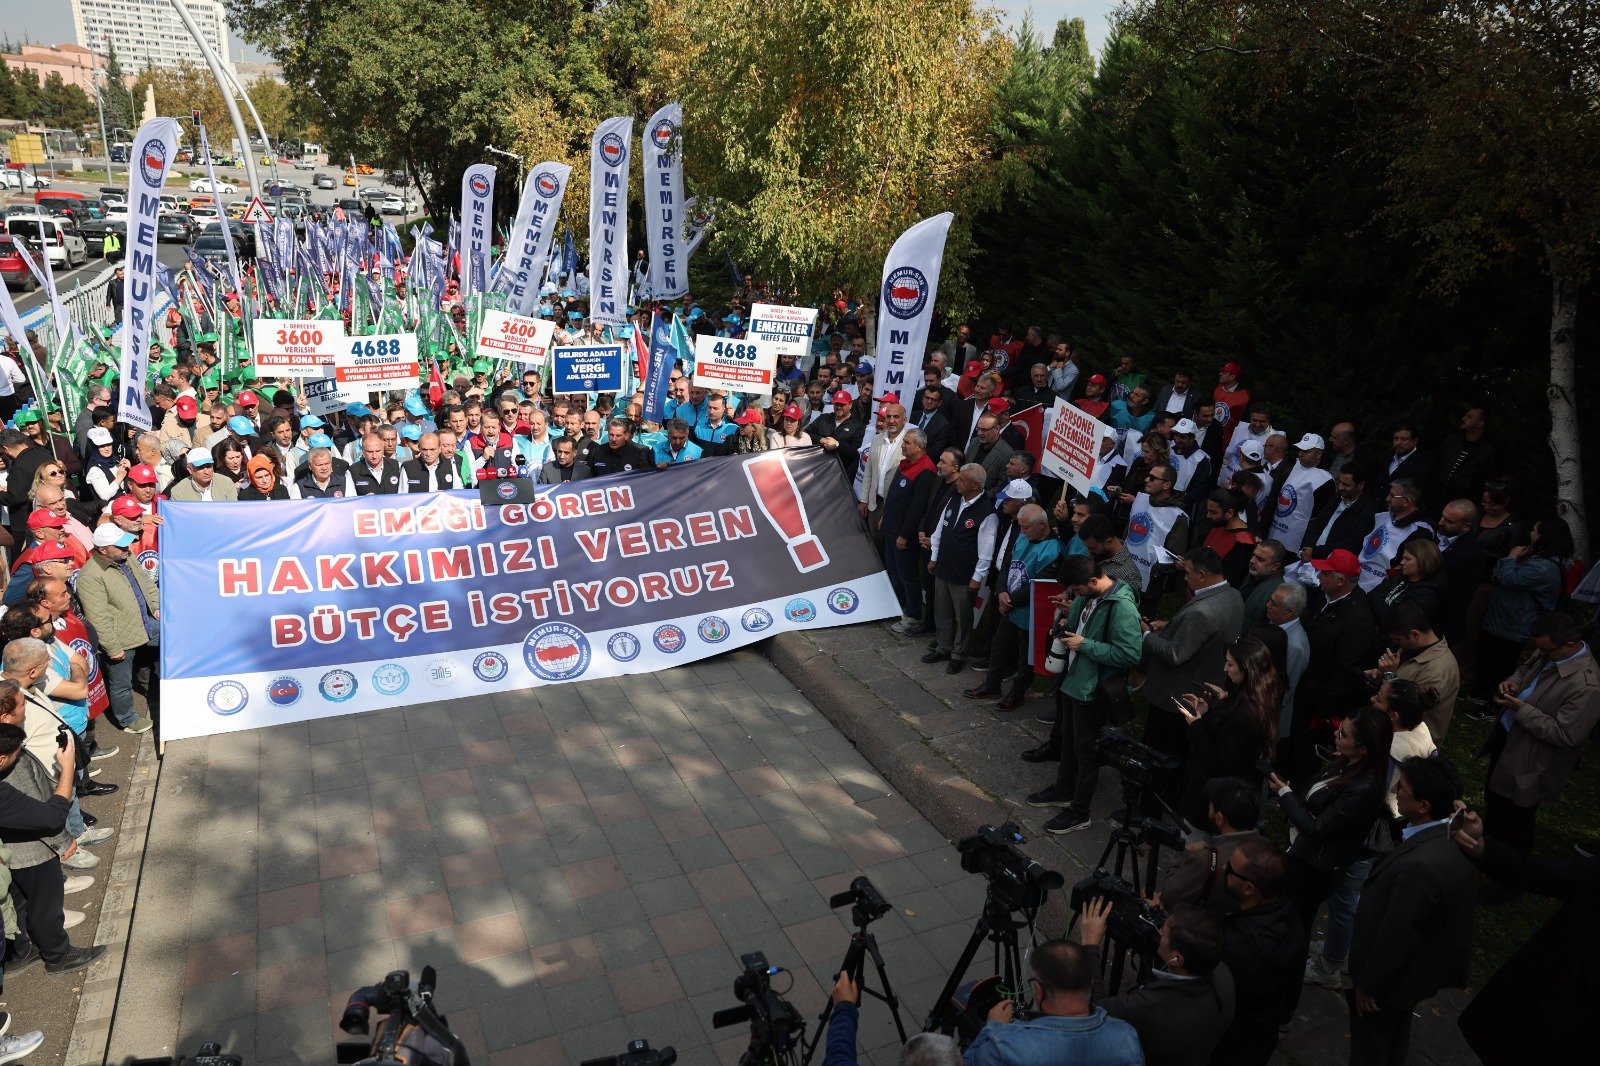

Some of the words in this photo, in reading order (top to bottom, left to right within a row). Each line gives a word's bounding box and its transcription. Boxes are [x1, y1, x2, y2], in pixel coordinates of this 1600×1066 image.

[472, 200, 485, 252] MEMU
[600, 172, 619, 315] MEMURSEN
[508, 200, 549, 311] MEMURSEN
[889, 269, 925, 286] MEMUR-SEN
[125, 193, 160, 410] MEMURSEN
[276, 330, 323, 345] 3600
[501, 321, 537, 338] 3600
[756, 320, 809, 335] EMEKLİLER
[351, 339, 401, 357] 4688
[761, 334, 780, 342] NEFES
[782, 335, 800, 343] ALSIN
[262, 356, 290, 364] AYRIM
[291, 356, 313, 364] SONA
[354, 357, 399, 365] GÜNCELLENSİN
[713, 342, 757, 360] 4688
[571, 363, 605, 373] VERGİ
[645, 347, 665, 414] BEM-BİR-SEN
[1060, 406, 1095, 437] PERSONEL
[1054, 419, 1095, 454] SİSTEMİNDE
[354, 502, 487, 537] EMEĞİ
[499, 485, 635, 526] GÖREN
[218, 534, 558, 596] HAKKIMIZI
[574, 505, 757, 562] VEREN
[270, 600, 453, 648] BÜTÇE
[467, 560, 735, 628] İSTİYORUZ
[528, 625, 581, 646] MEMUR-SEN
